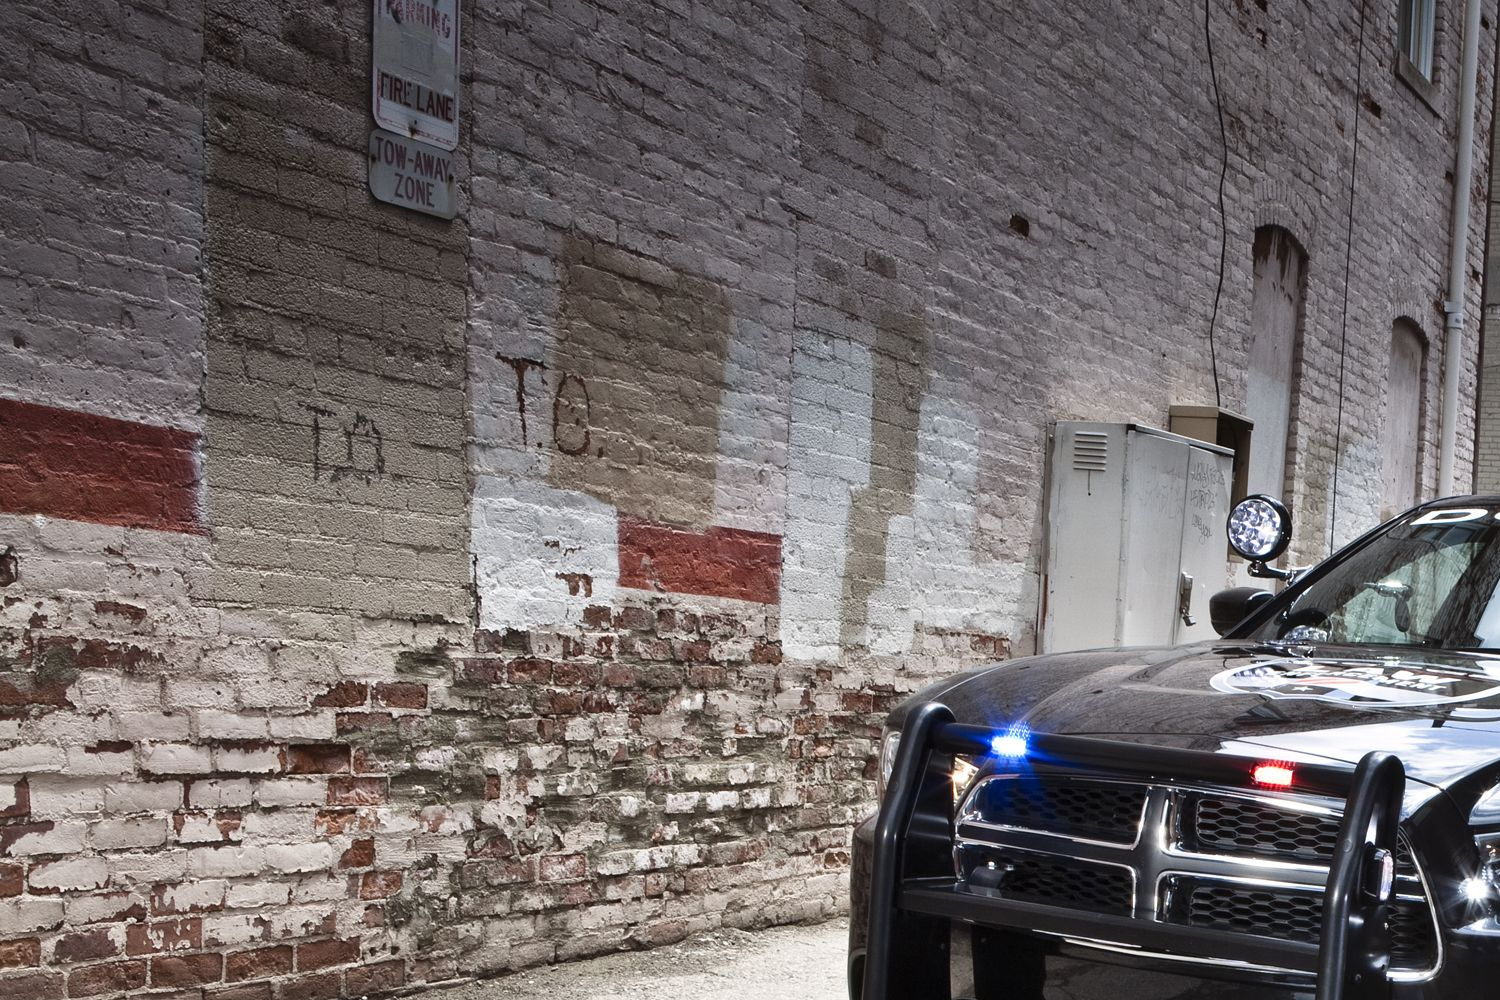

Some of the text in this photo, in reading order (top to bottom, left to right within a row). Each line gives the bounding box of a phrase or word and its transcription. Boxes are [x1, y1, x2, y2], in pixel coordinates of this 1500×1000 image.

[380, 71, 454, 123] FIRE LANE
[375, 136, 451, 182] TOW-AWAY
[394, 172, 435, 208] ZONE
